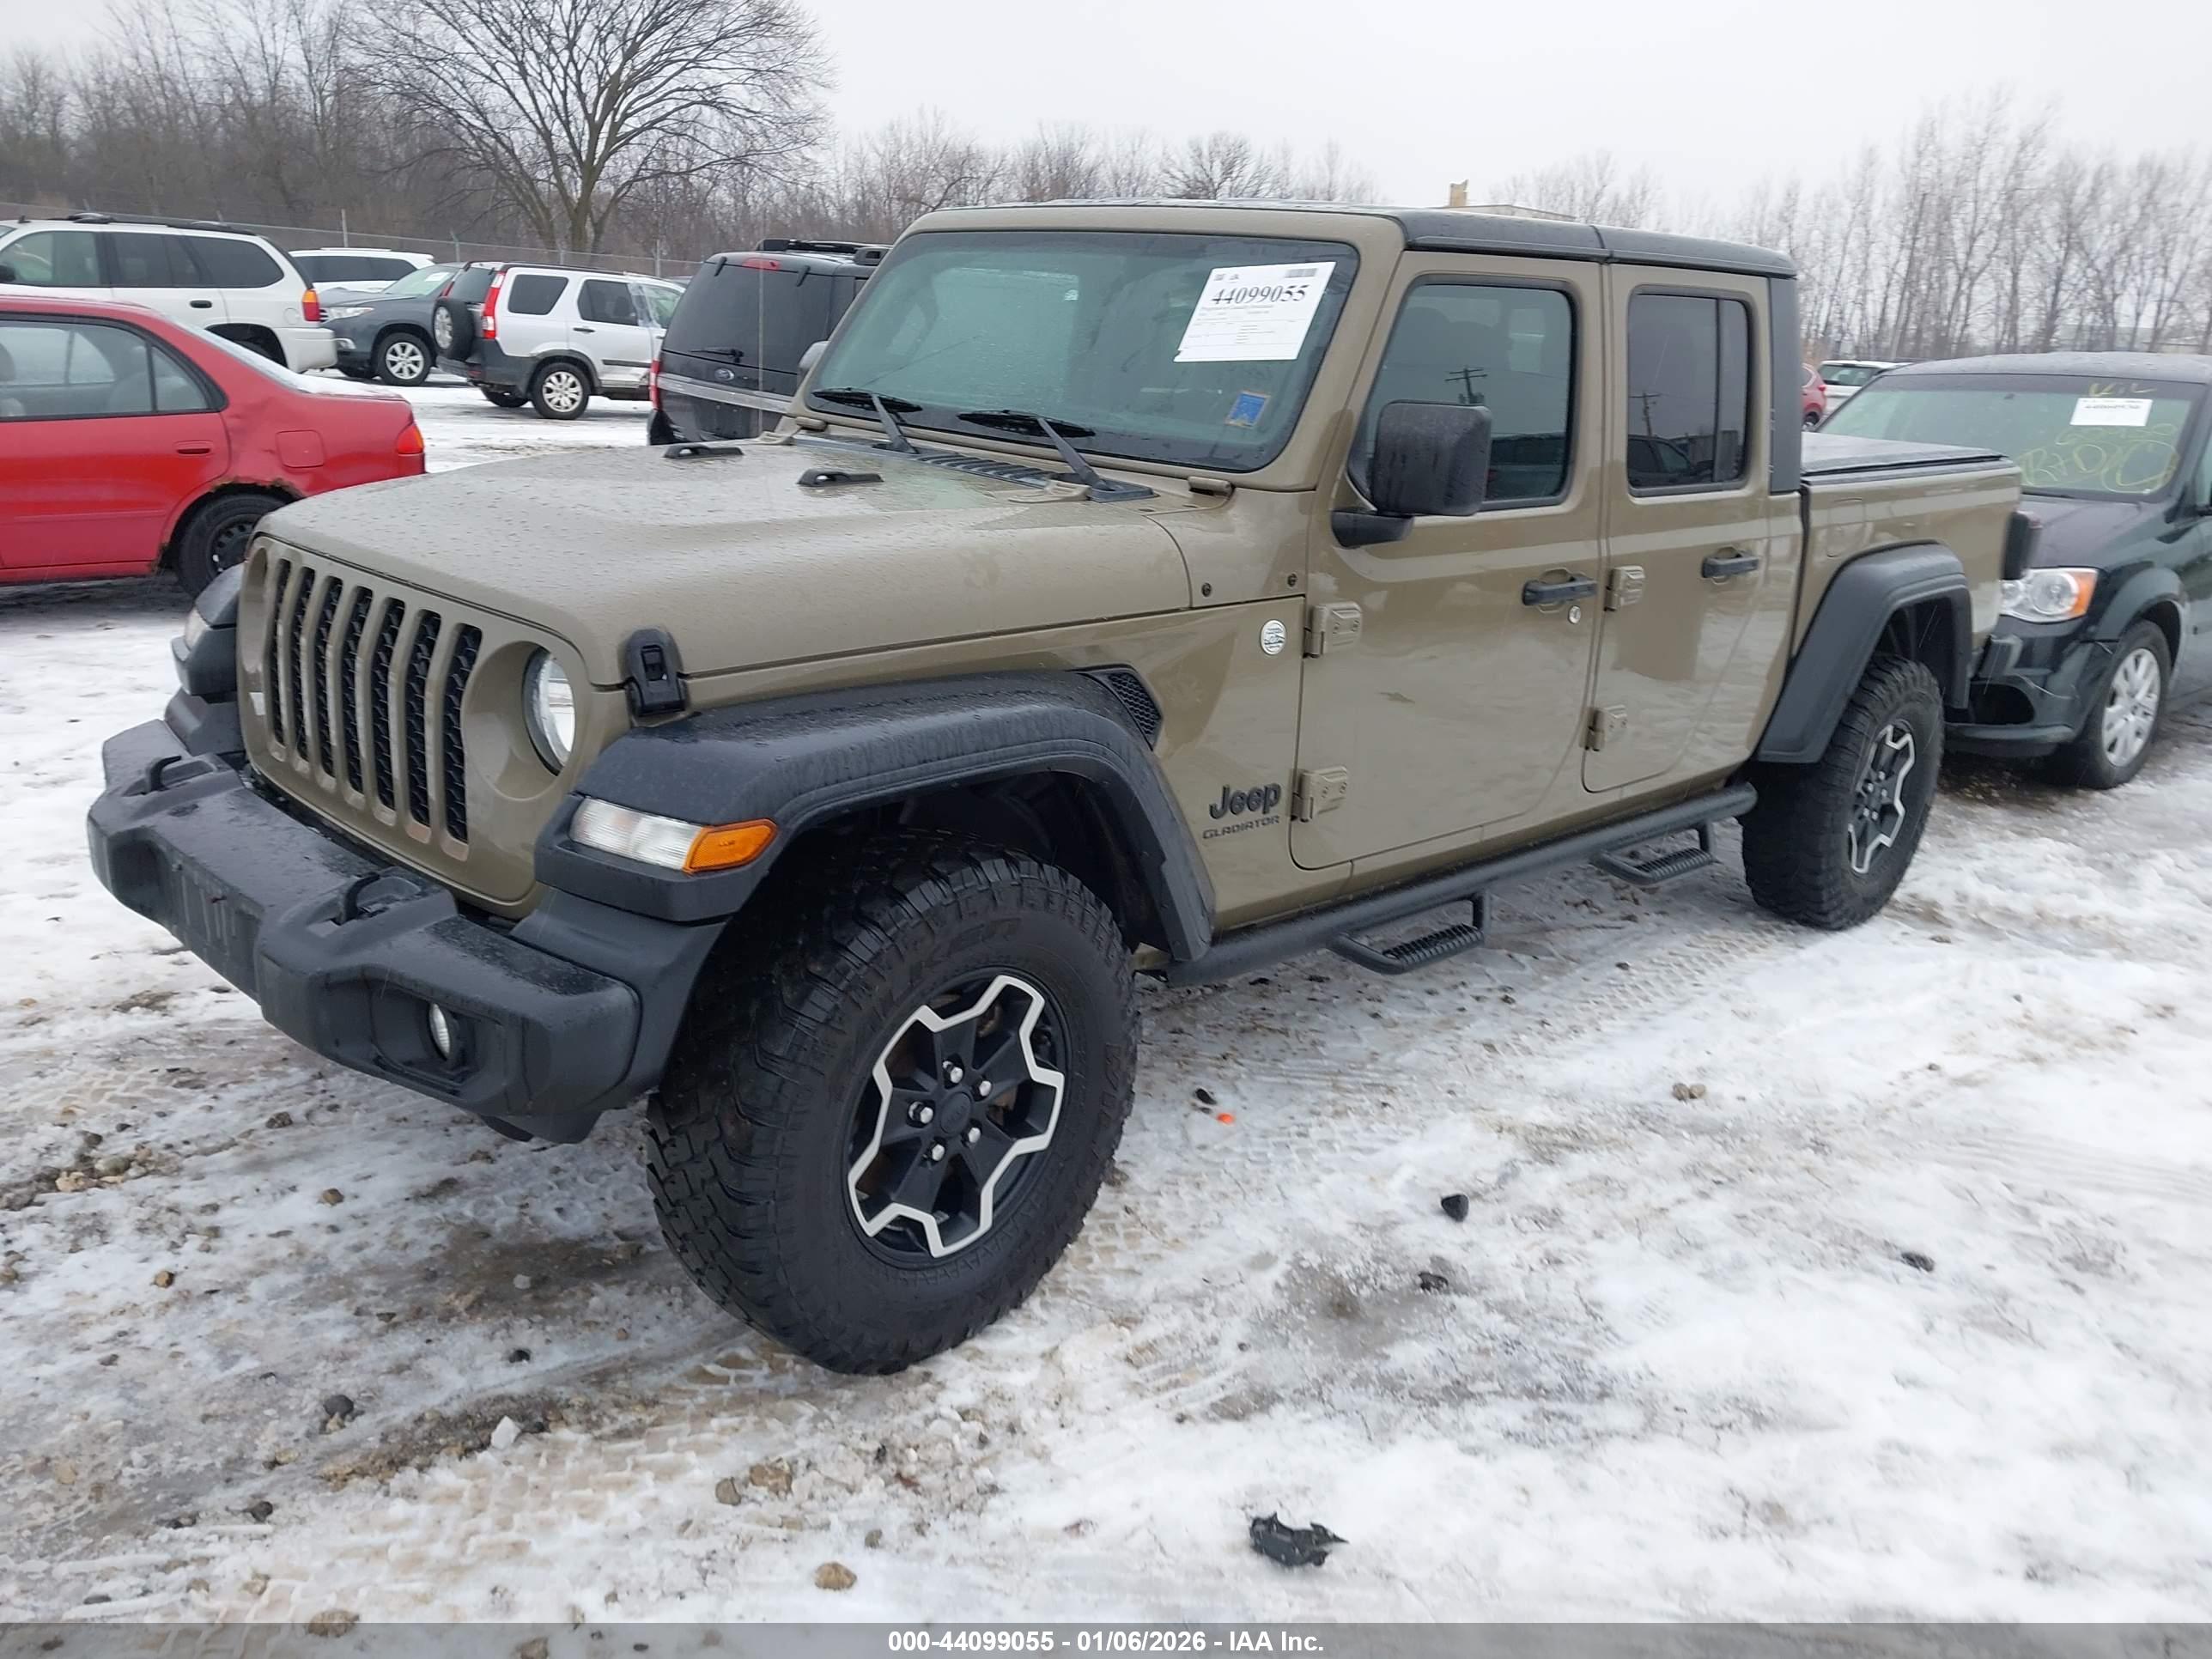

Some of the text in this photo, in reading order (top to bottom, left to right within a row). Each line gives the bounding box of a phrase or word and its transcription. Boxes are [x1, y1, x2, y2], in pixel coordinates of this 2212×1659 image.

[1212, 284, 1310, 305] 44099055
[1209, 782, 1281, 819] Jeep
[1202, 815, 1280, 840] GLADIATOR
